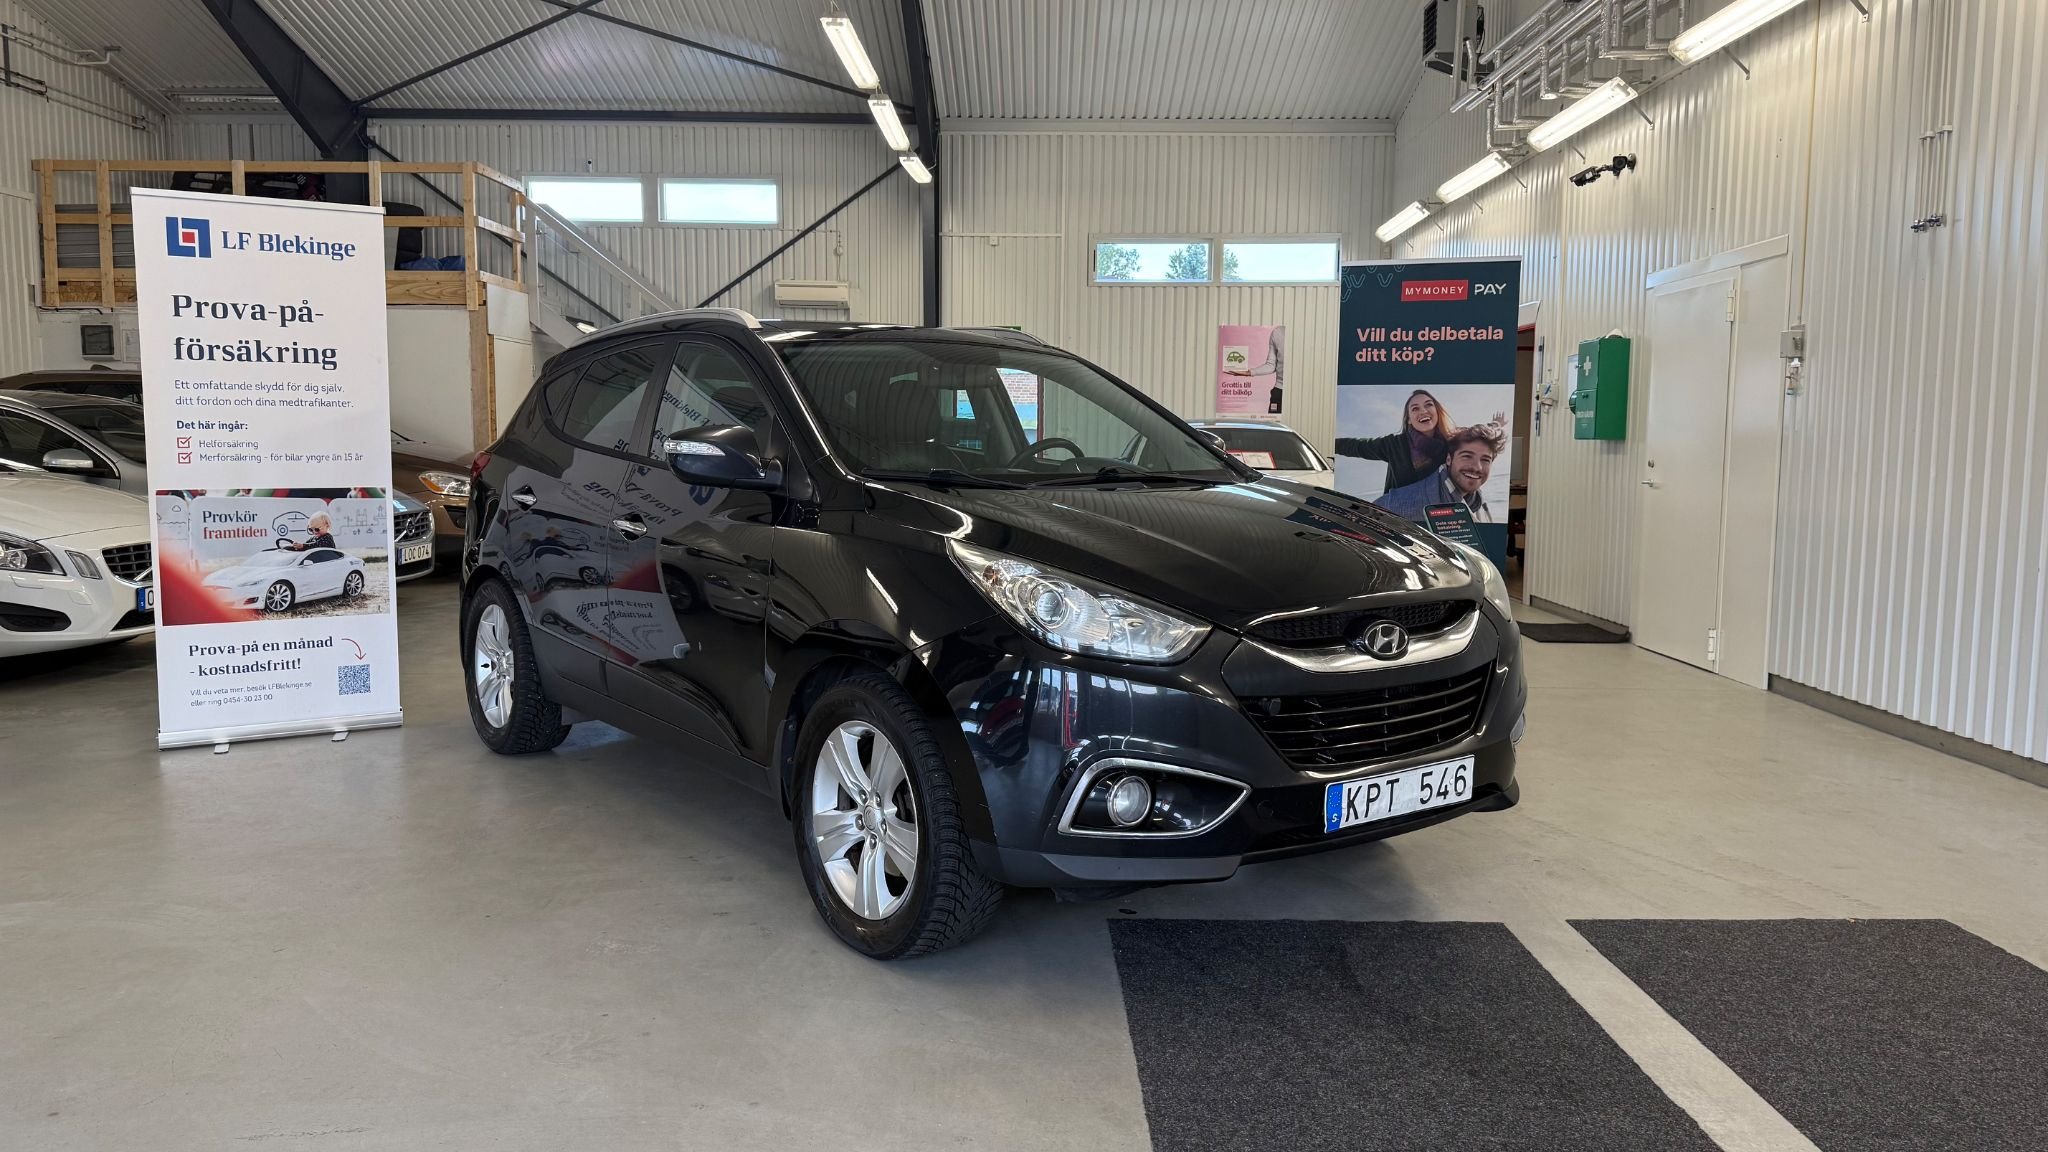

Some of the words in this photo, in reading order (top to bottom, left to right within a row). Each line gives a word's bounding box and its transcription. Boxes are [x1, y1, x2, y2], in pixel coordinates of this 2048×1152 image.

[221, 230, 252, 250] LF
[258, 233, 356, 261] Blekinge
[1405, 286, 1464, 296] MYMONEY
[1474, 283, 1507, 296] PAY
[171, 294, 325, 328] Prova-på-
[1356, 327, 1386, 342] Vill
[1390, 327, 1413, 342] du
[1417, 325, 1504, 341] delbetala
[173, 336, 339, 371] försäkring
[1355, 348, 1387, 362] ditt
[1391, 346, 1435, 365] köp?
[174, 380, 191, 390] Ett
[192, 380, 253, 391] omfattande
[254, 381, 285, 393] skydd
[287, 382, 302, 391] för
[304, 382, 319, 394] dig
[175, 396, 195, 406] ditt
[196, 396, 232, 406] fordon
[234, 396, 253, 406] och
[255, 397, 277, 407] dina
[279, 397, 355, 408] medtrafikanter.
[176, 420, 196, 430] Det
[198, 421, 216, 430] här
[218, 420, 249, 432] ingår:
[198, 440, 259, 450] Helförsäkring
[199, 453, 262, 464] Merförsäkring
[270, 453, 283, 462] för
[285, 453, 303, 462] bilar
[305, 454, 330, 464] yngre
[331, 453, 342, 461] än
[354, 453, 364, 461] år
[202, 510, 258, 523] Provkör
[203, 525, 268, 540] framtiden
[188, 640, 259, 657] Prova-på
[262, 641, 280, 652] en
[283, 636, 333, 651] månad
[198, 657, 301, 677] kostnadsfritt!
[203, 688, 212, 696] du
[1345, 777, 1400, 822] KPT
[1419, 764, 1467, 804] 546
